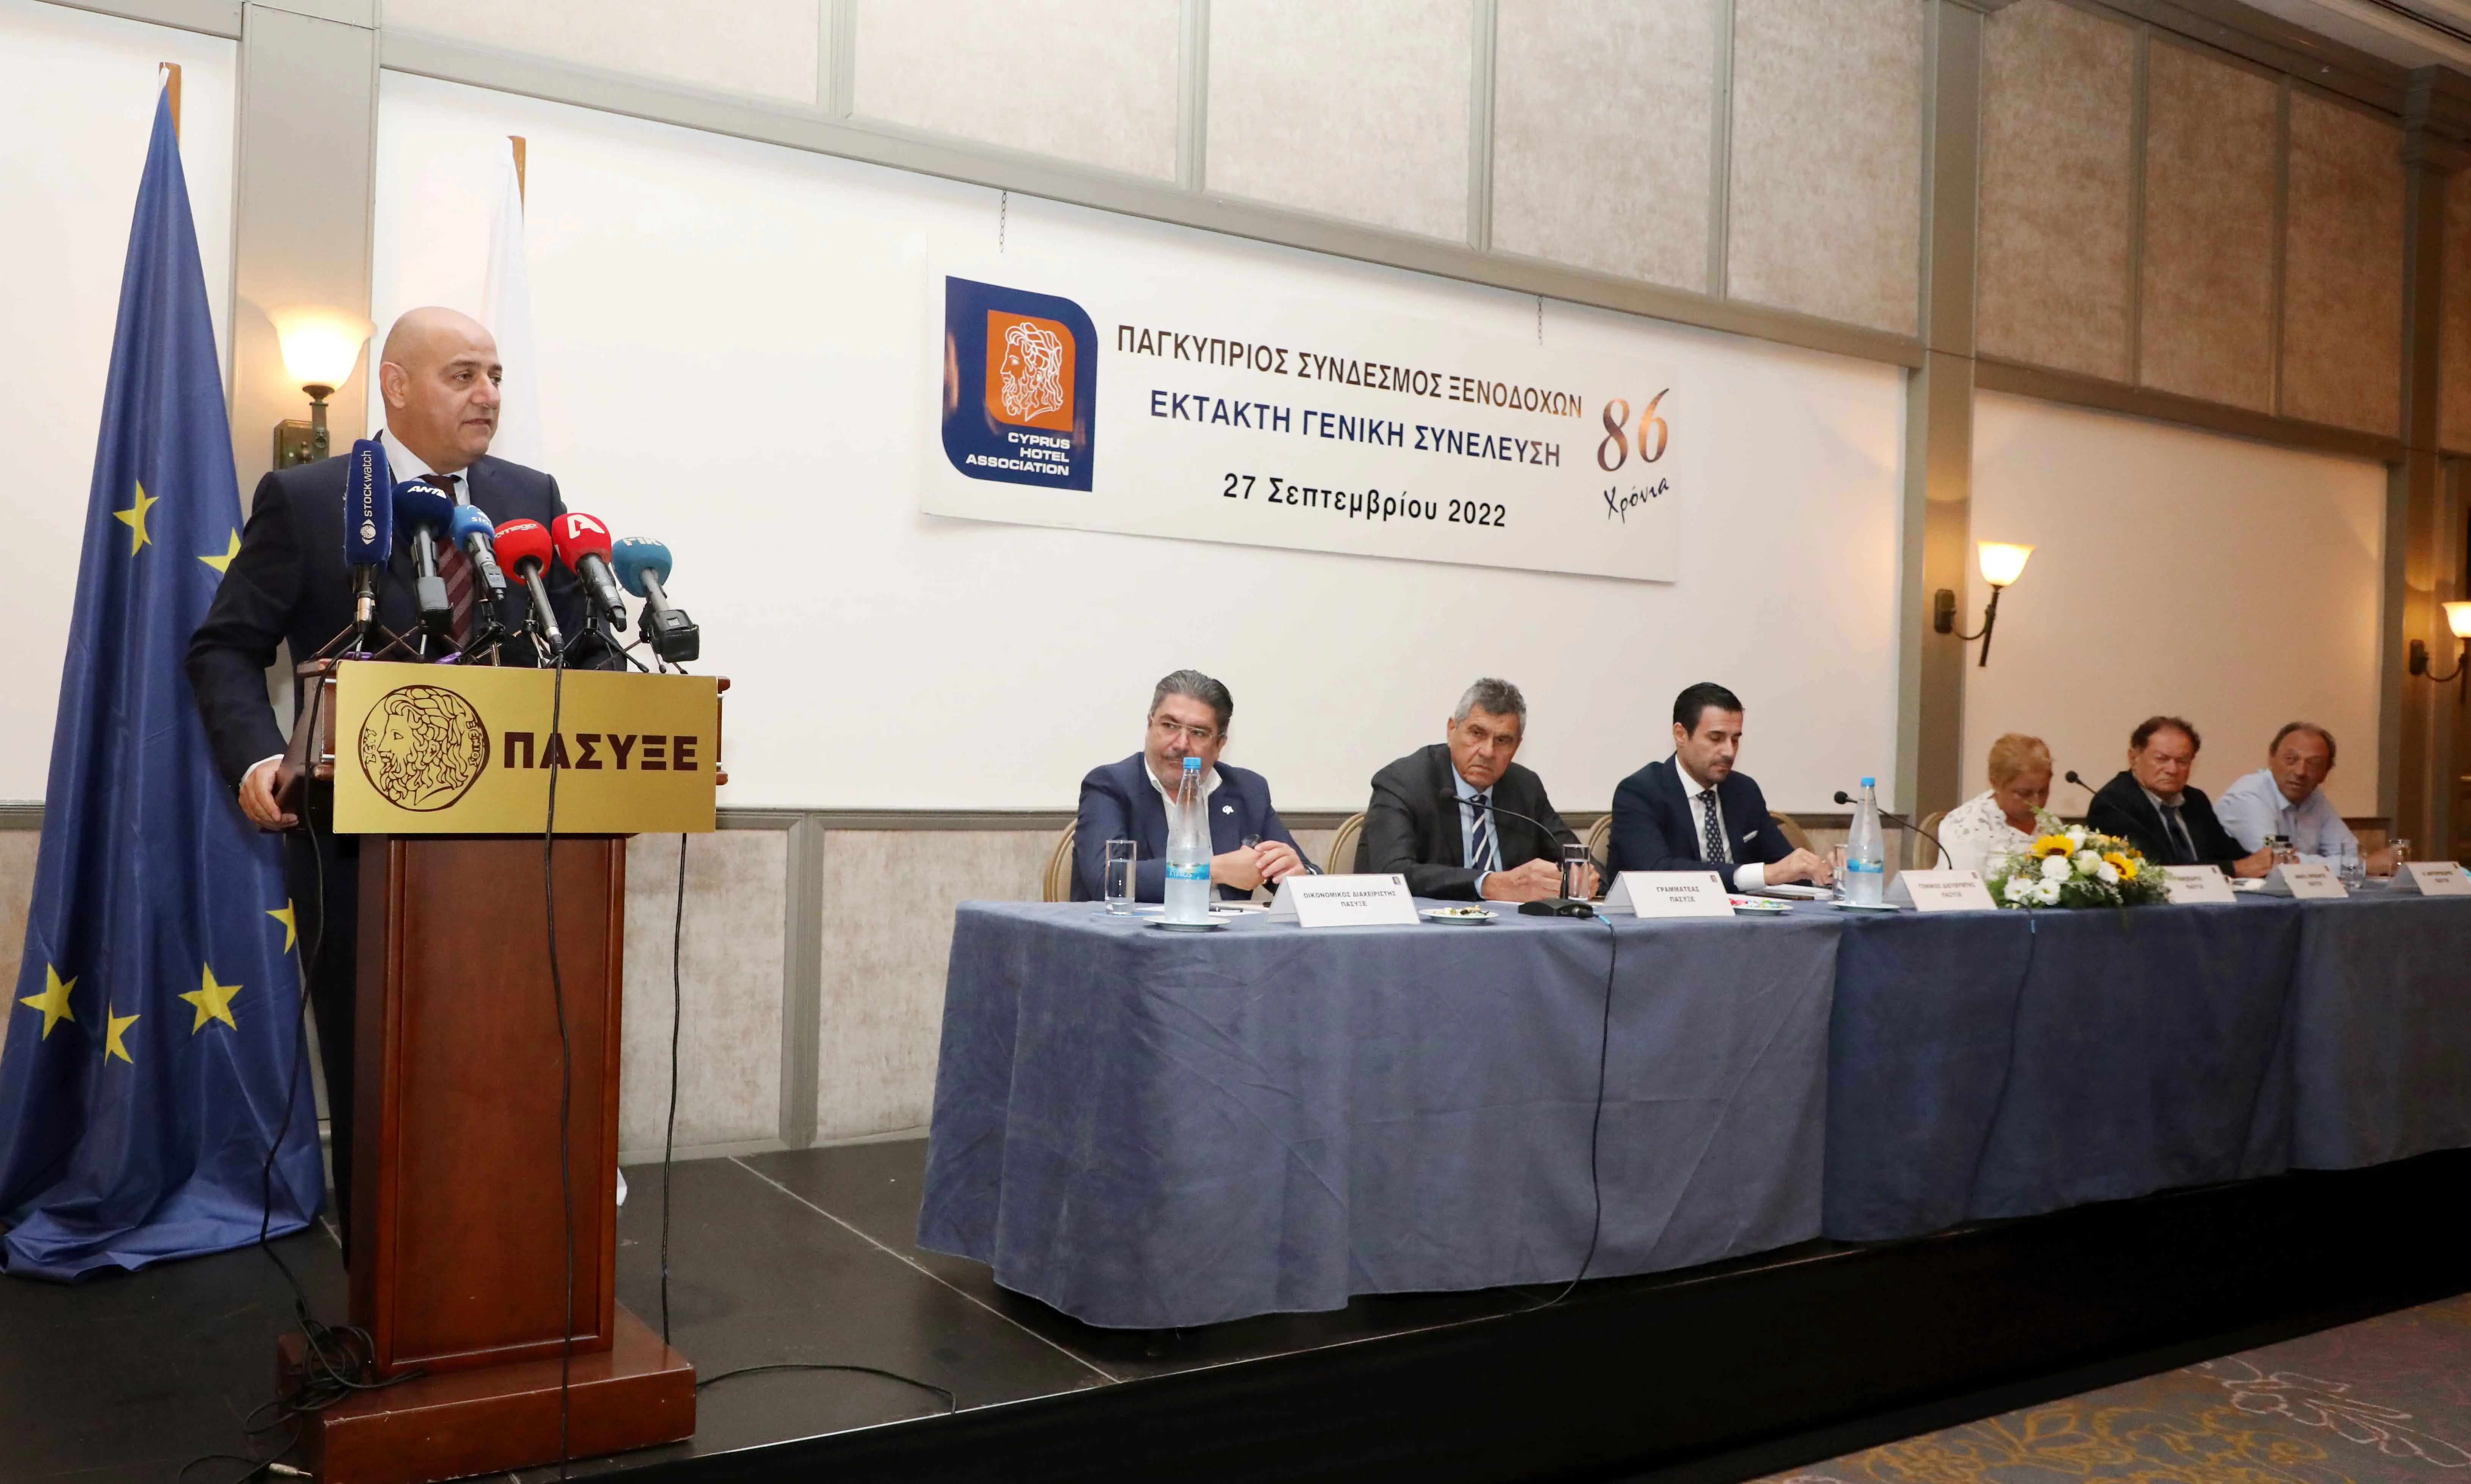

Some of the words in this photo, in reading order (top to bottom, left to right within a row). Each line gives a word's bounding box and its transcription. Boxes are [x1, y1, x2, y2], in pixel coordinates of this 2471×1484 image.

[1118, 325, 1288, 374] ΠΑΓΚΥΠΡΙΟΣ
[1298, 352, 1442, 398] ΣΥΝΔΕΣΜΟΣ
[1448, 376, 1582, 419] ΞΕΝΟΔΟΧΩΝ
[1007, 432, 1071, 450] CYPRUS
[1151, 390, 1290, 433] ΕΚΤΑΚΤΗ
[1303, 410, 1404, 447] ΓΕΝΙΚΗ
[1414, 425, 1560, 467] ΣΥΝΕΛΕΥΣΗ
[1597, 388, 1670, 472] 86
[965, 454, 1069, 476] ASSOCIATION
[1020, 447, 1070, 463] HOTEL
[1223, 473, 1256, 500] 27
[1268, 477, 1437, 521] Σεπτεμβρίου
[1448, 499, 1506, 527] 2022
[1604, 477, 1670, 524] Χρόνια
[504, 732, 698, 771] ΠΑΣΥΞΕ
